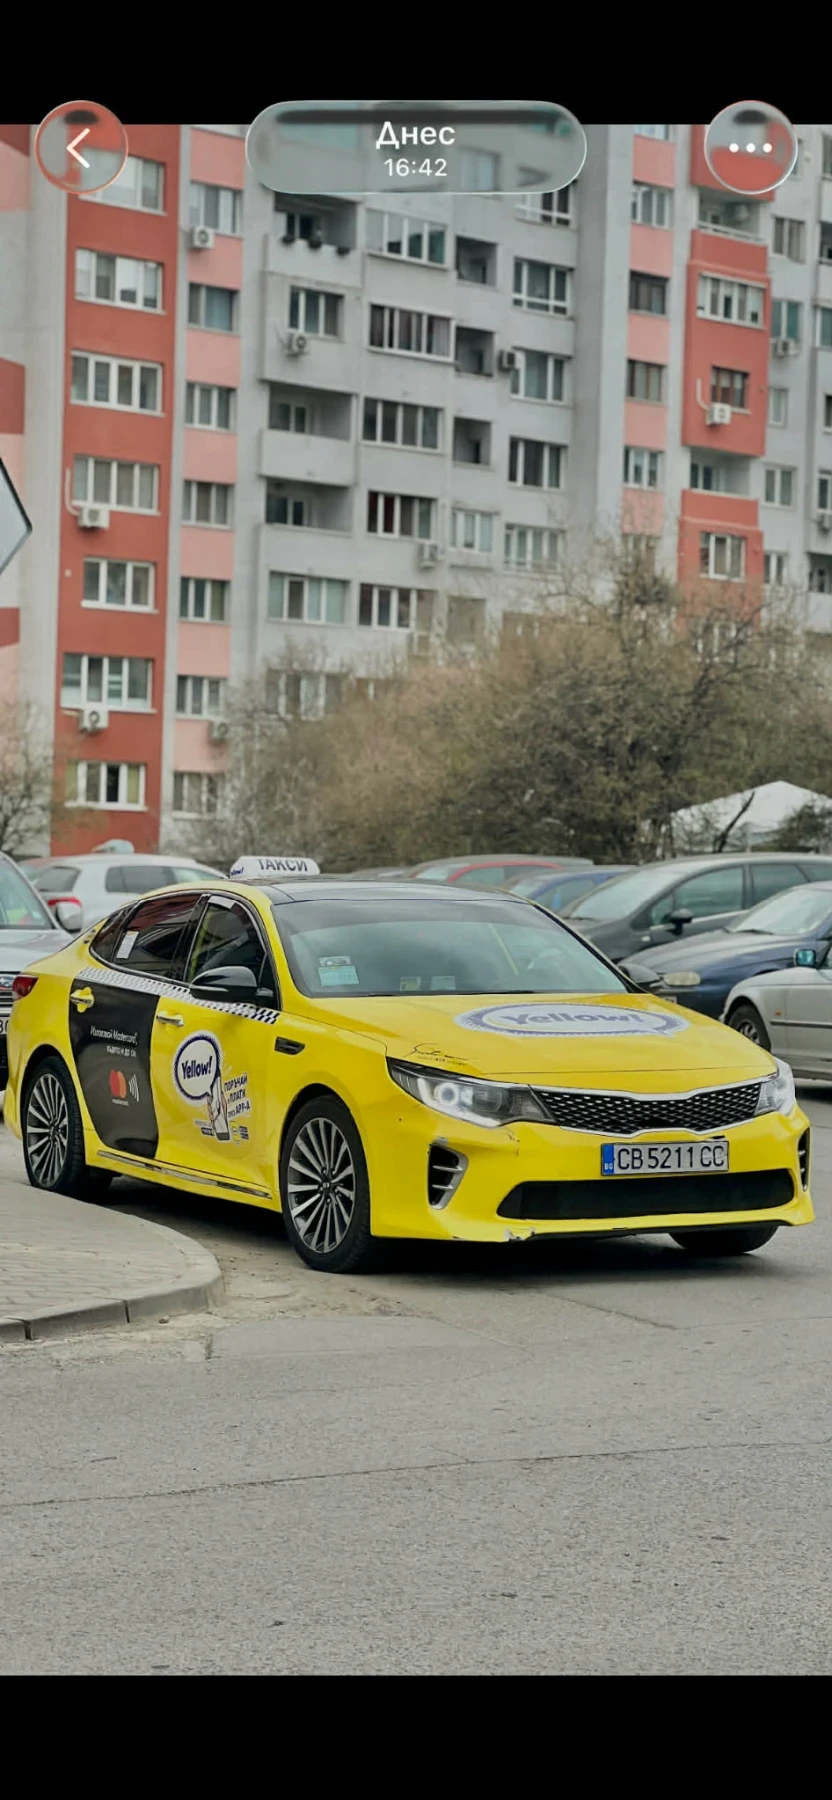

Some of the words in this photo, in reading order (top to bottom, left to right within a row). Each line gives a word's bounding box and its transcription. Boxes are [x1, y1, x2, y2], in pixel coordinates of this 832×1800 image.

[258, 859, 308, 872] ТАКСИ
[500, 1013, 645, 1025] Yellow!
[181, 1055, 213, 1080] Yellow!
